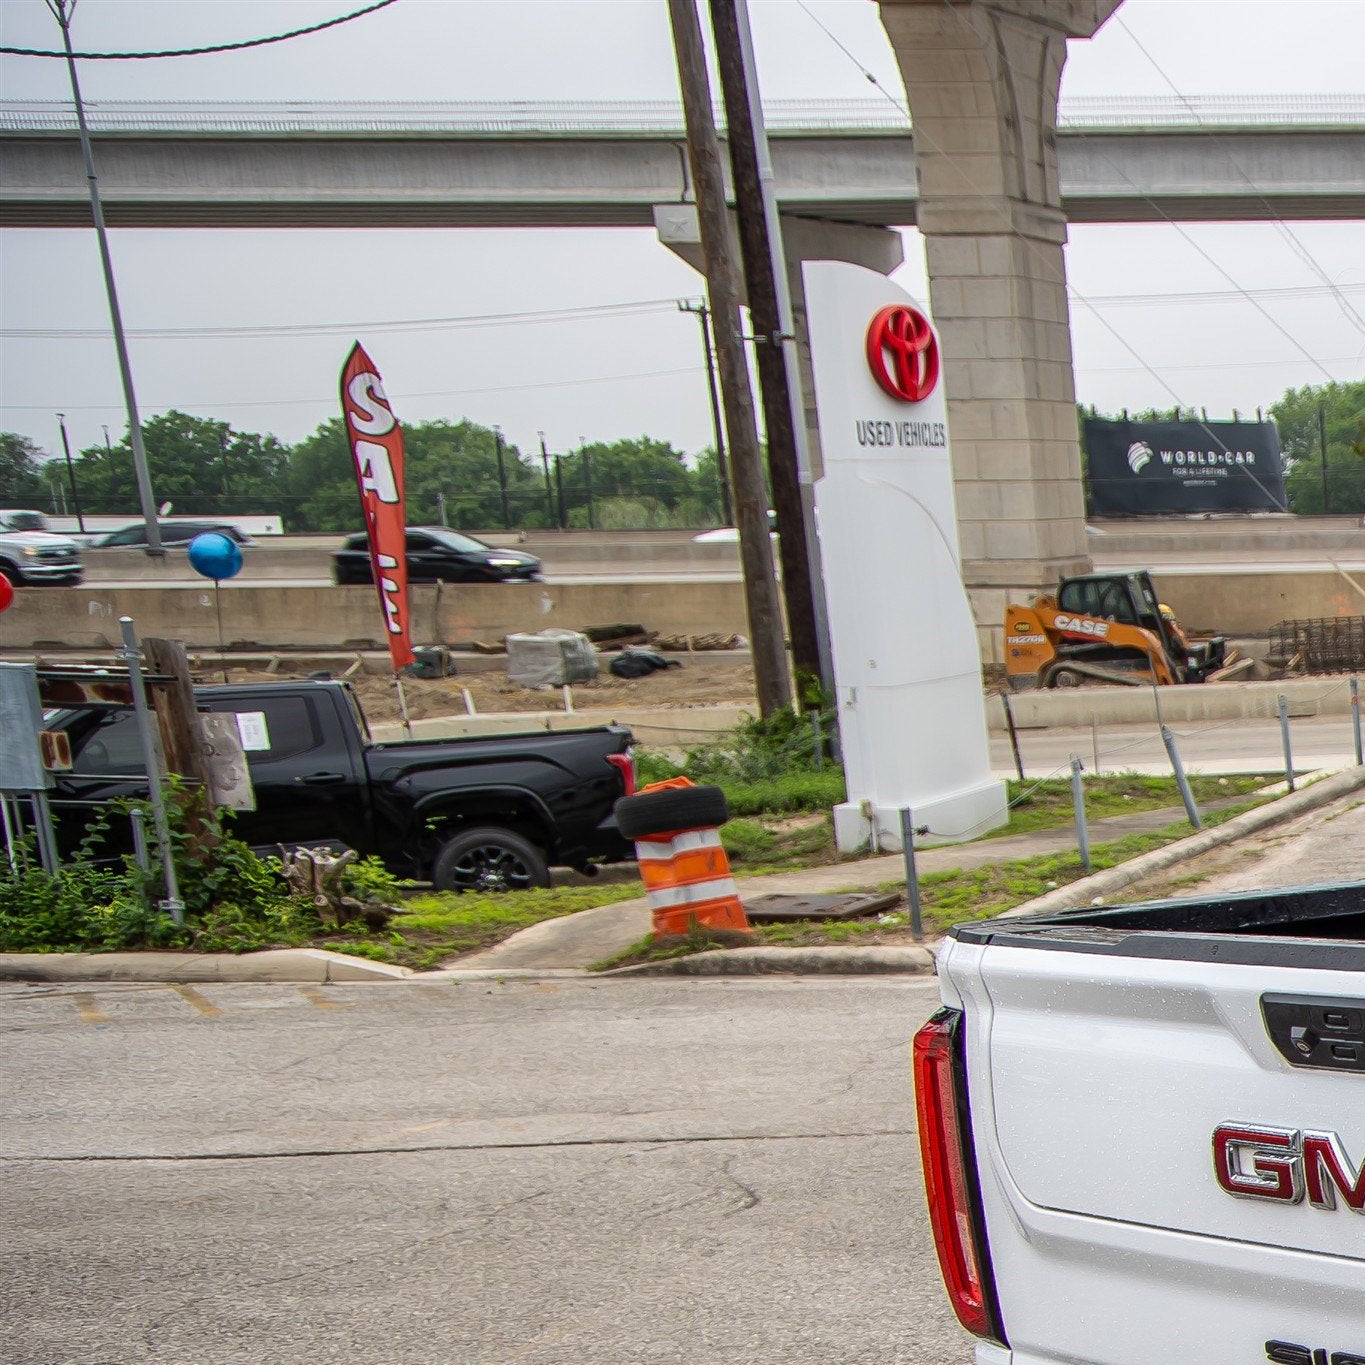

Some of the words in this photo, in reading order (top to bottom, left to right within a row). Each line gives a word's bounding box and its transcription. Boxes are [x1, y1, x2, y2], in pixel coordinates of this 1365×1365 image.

[855, 419, 894, 446] USED
[894, 420, 946, 448] VEHICLES
[348, 371, 403, 635] SAE
[1053, 614, 1110, 637] CASE
